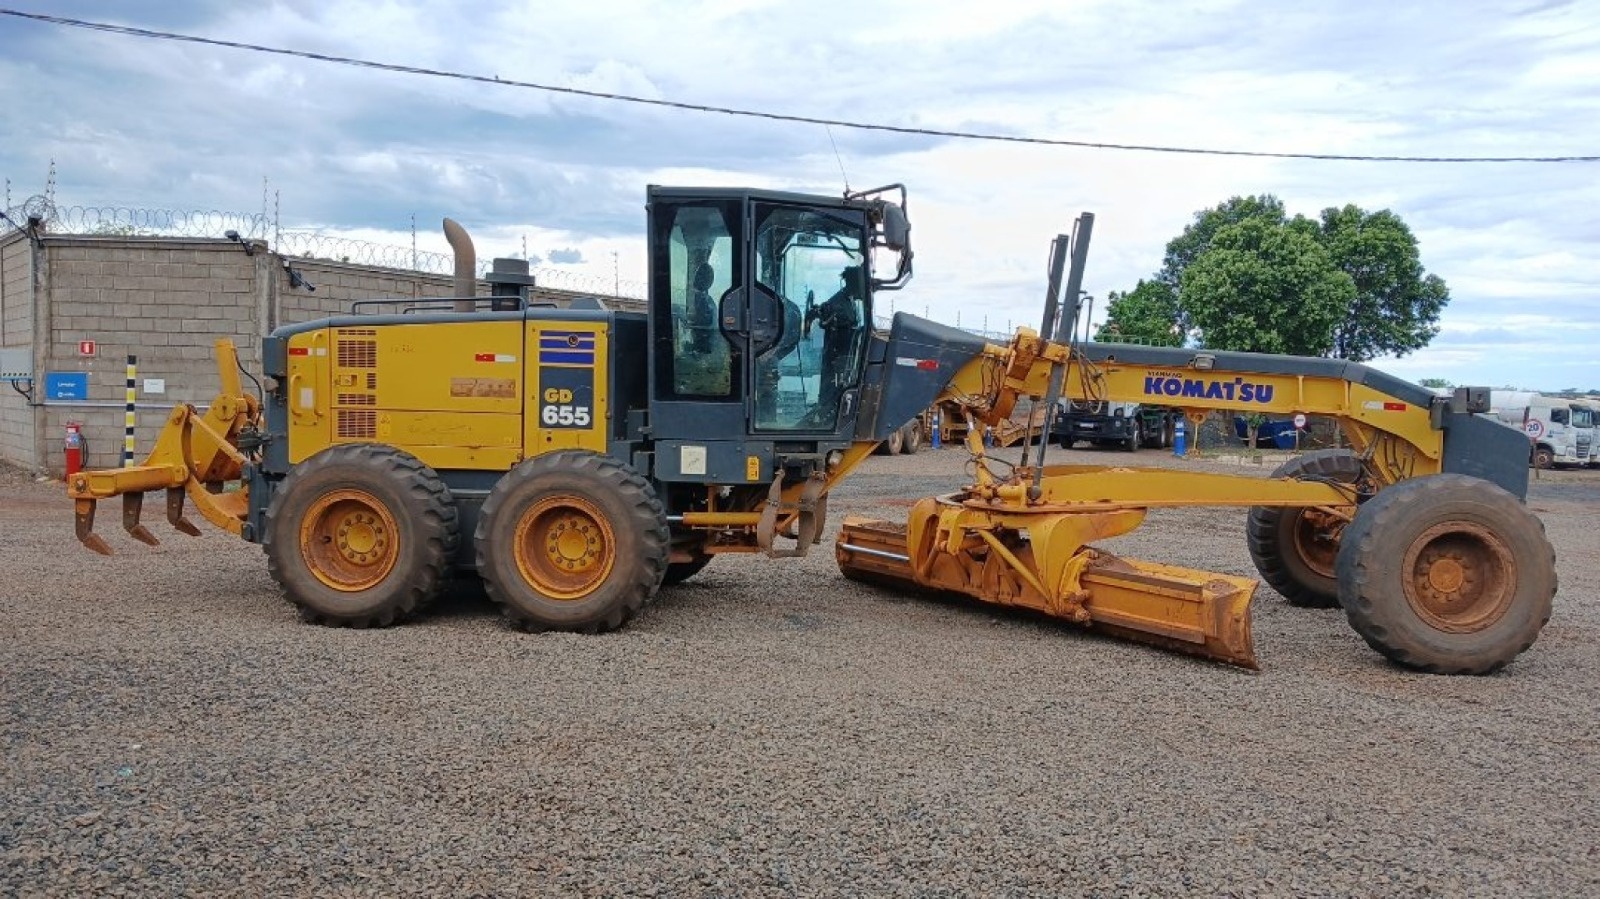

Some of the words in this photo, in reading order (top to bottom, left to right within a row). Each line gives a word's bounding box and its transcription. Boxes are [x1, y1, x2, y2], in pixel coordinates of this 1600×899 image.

[544, 387, 573, 403] GD
[1144, 377, 1273, 403] KOMATSU
[543, 405, 590, 426] 655
[1528, 423, 1539, 432] 20
